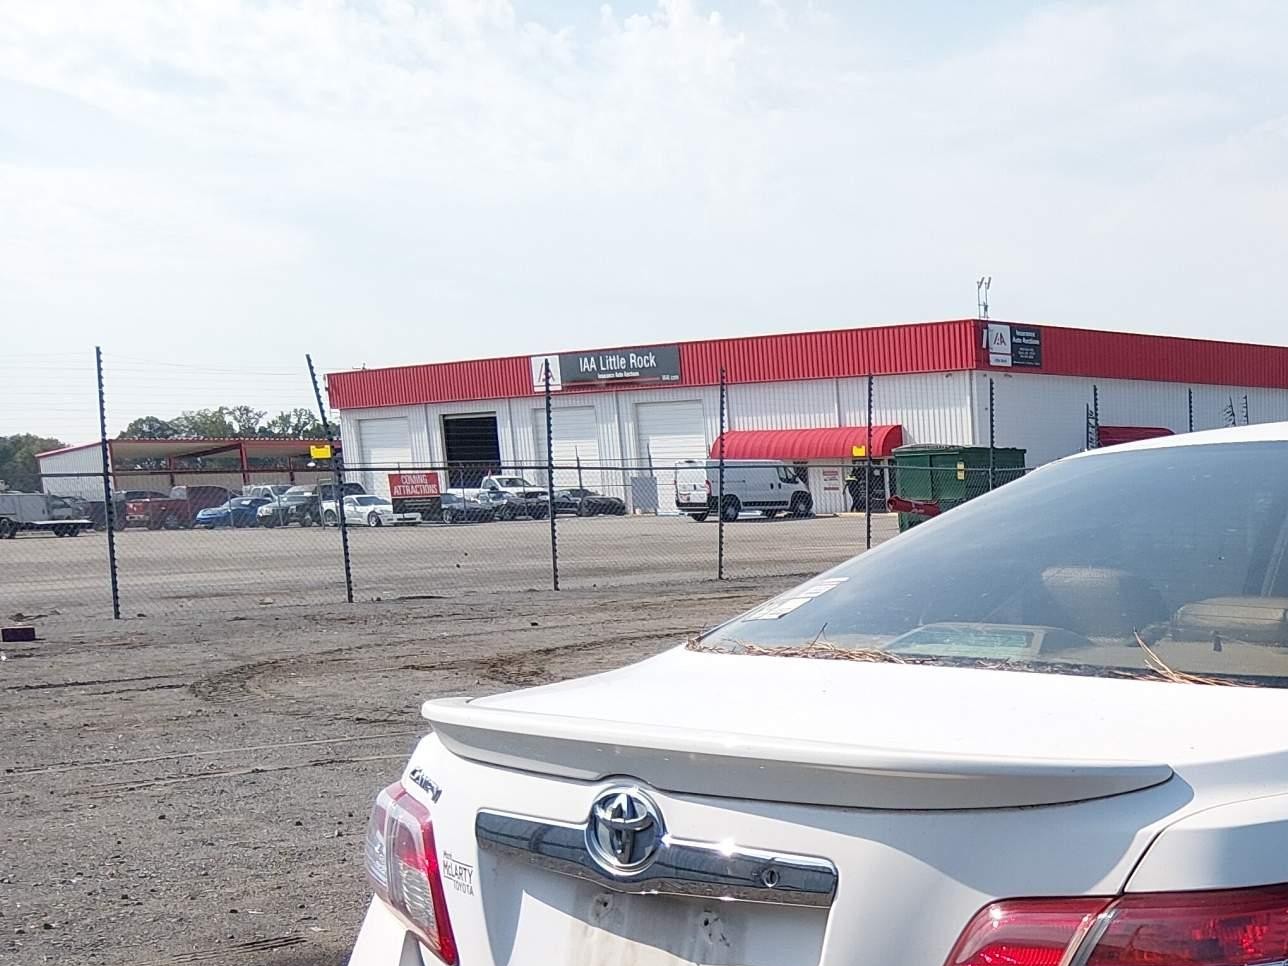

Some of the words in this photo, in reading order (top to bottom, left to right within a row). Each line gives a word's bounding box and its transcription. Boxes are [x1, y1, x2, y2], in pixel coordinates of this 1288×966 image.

[579, 357, 597, 372] IAA
[599, 355, 627, 371] Little
[629, 352, 657, 369] Rock
[400, 475, 428, 484] COMING
[393, 485, 438, 495] ATTRACTIONS
[453, 879, 474, 897] TOYOTA
